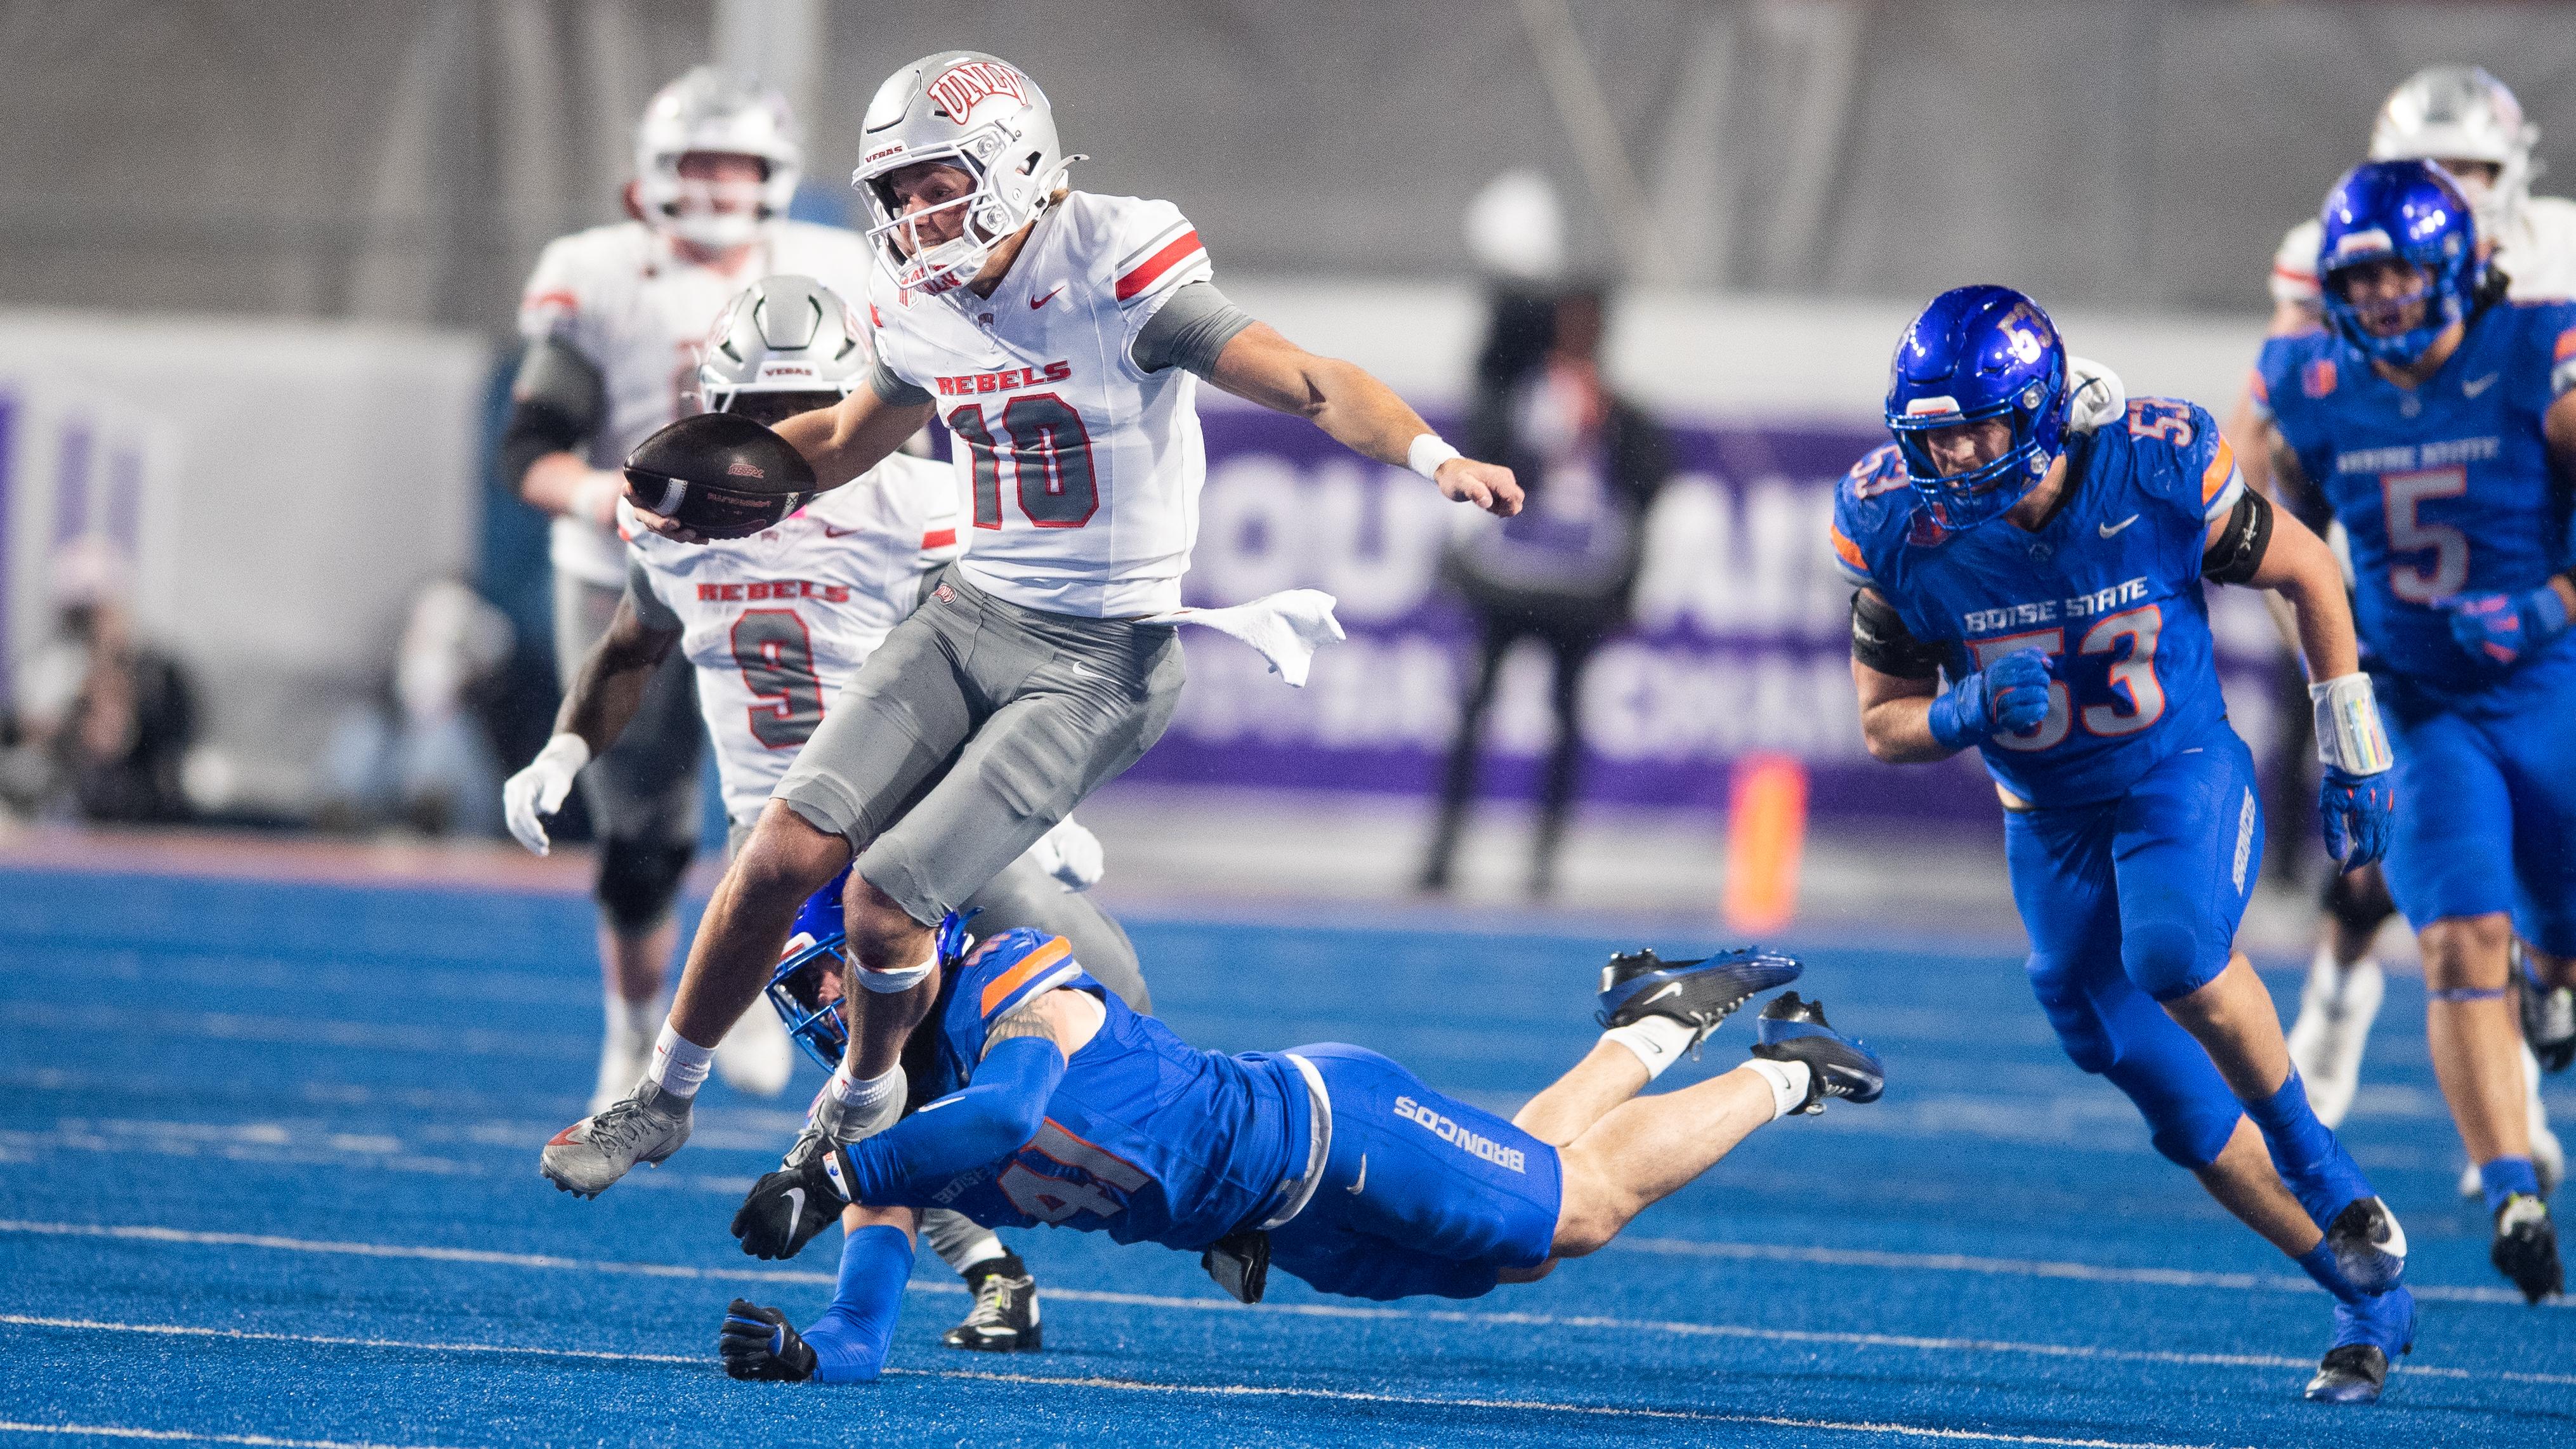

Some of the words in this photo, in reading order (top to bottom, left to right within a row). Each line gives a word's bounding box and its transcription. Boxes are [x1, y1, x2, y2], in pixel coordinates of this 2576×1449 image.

[926, 62, 1028, 126] UNLV
[865, 145, 904, 163] VEGAS
[766, 367, 812, 377] VEGAS
[934, 360, 1072, 395] REBELS
[947, 391, 1100, 531] 10
[2380, 463, 2471, 604] 5
[697, 580, 850, 603] REBELS
[1964, 600, 2058, 633] BOISE
[2065, 575, 2149, 617] STATE
[730, 608, 825, 751] 9
[1963, 603, 2165, 752] 53
[996, 1115, 1155, 1224] 41
[1393, 1096, 1527, 1174] BRONCOS
